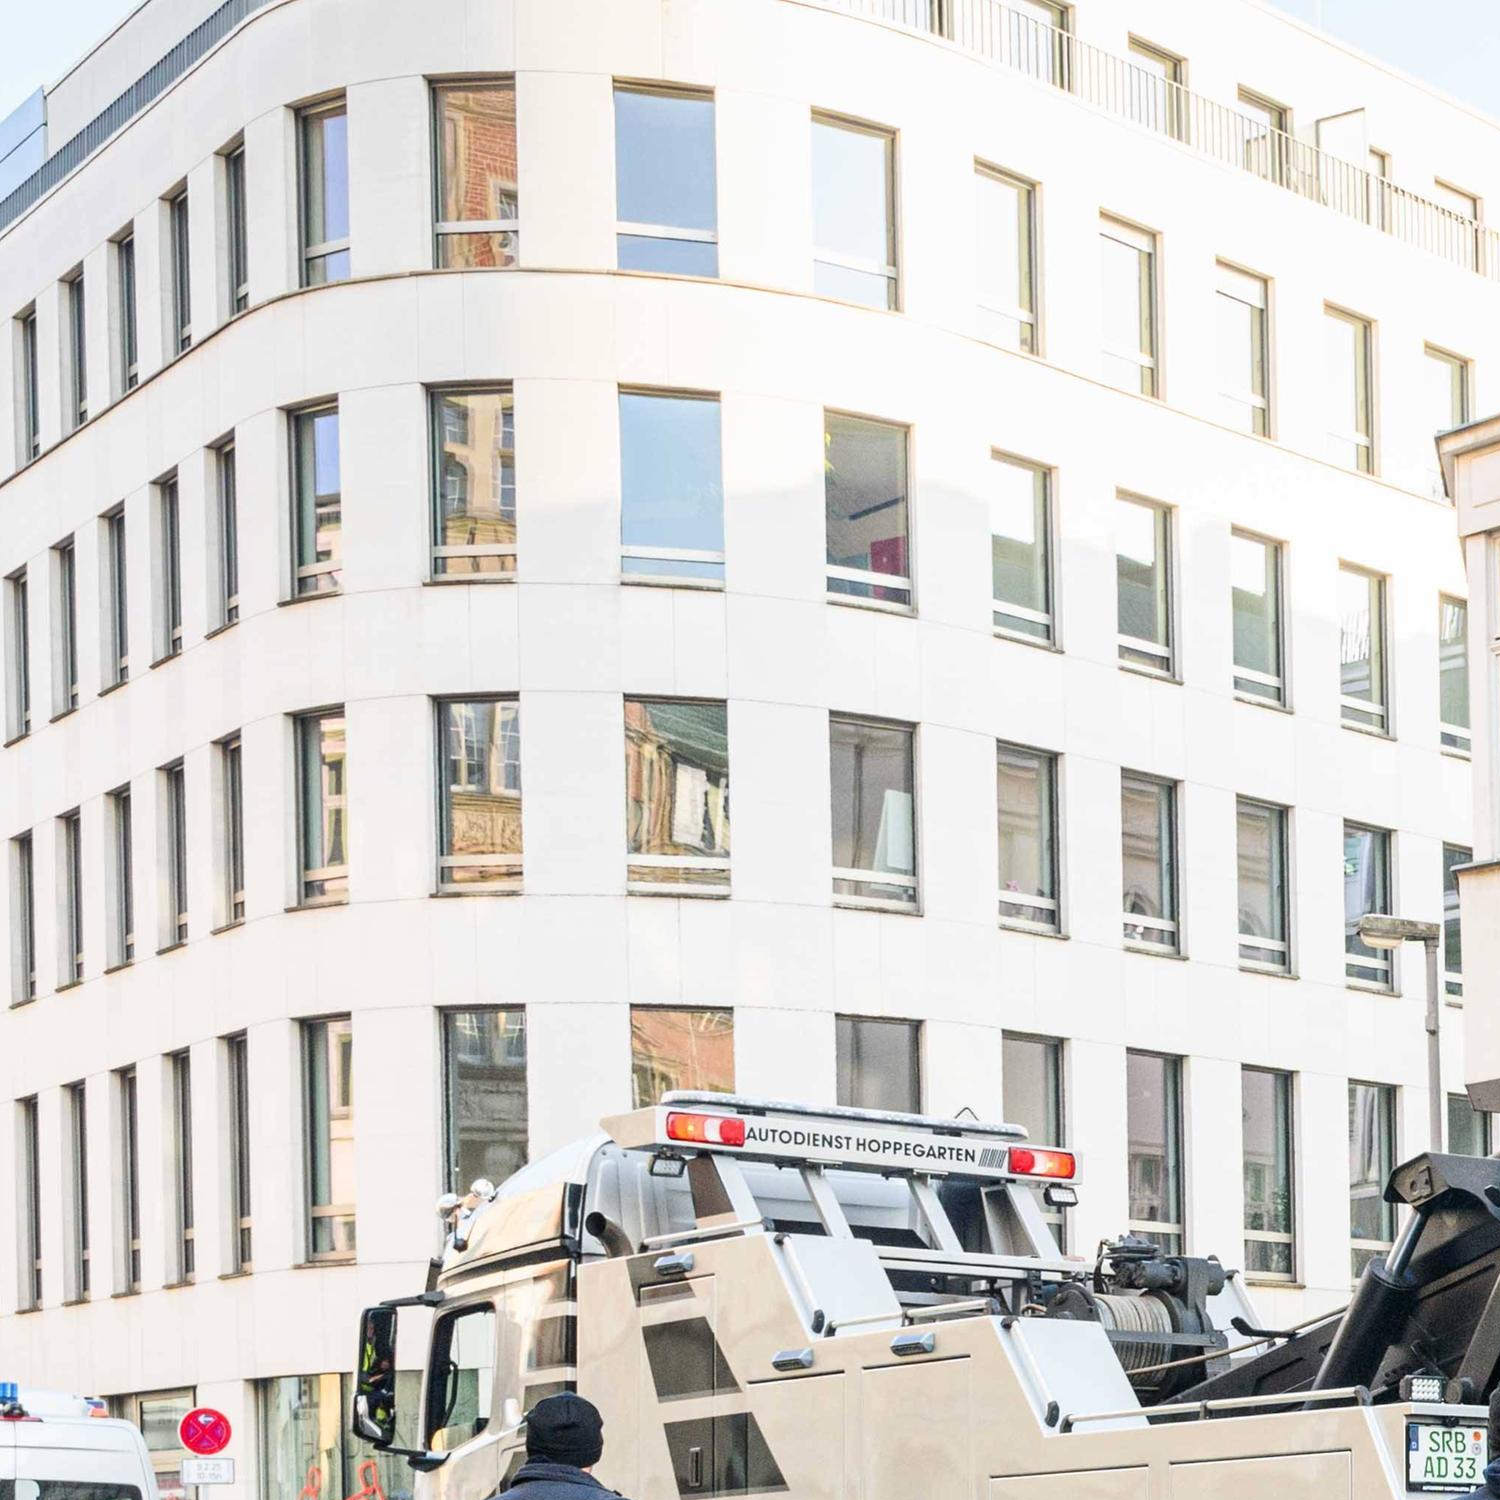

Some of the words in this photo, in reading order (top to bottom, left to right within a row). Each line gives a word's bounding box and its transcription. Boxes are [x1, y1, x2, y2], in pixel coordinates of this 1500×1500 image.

[746, 1126, 853, 1151] AUTODIENST
[856, 1137, 976, 1163] HOPPEGARTEN
[1428, 1430, 1467, 1454] SRB
[1423, 1456, 1449, 1479] AD
[1453, 1456, 1477, 1479] 33
